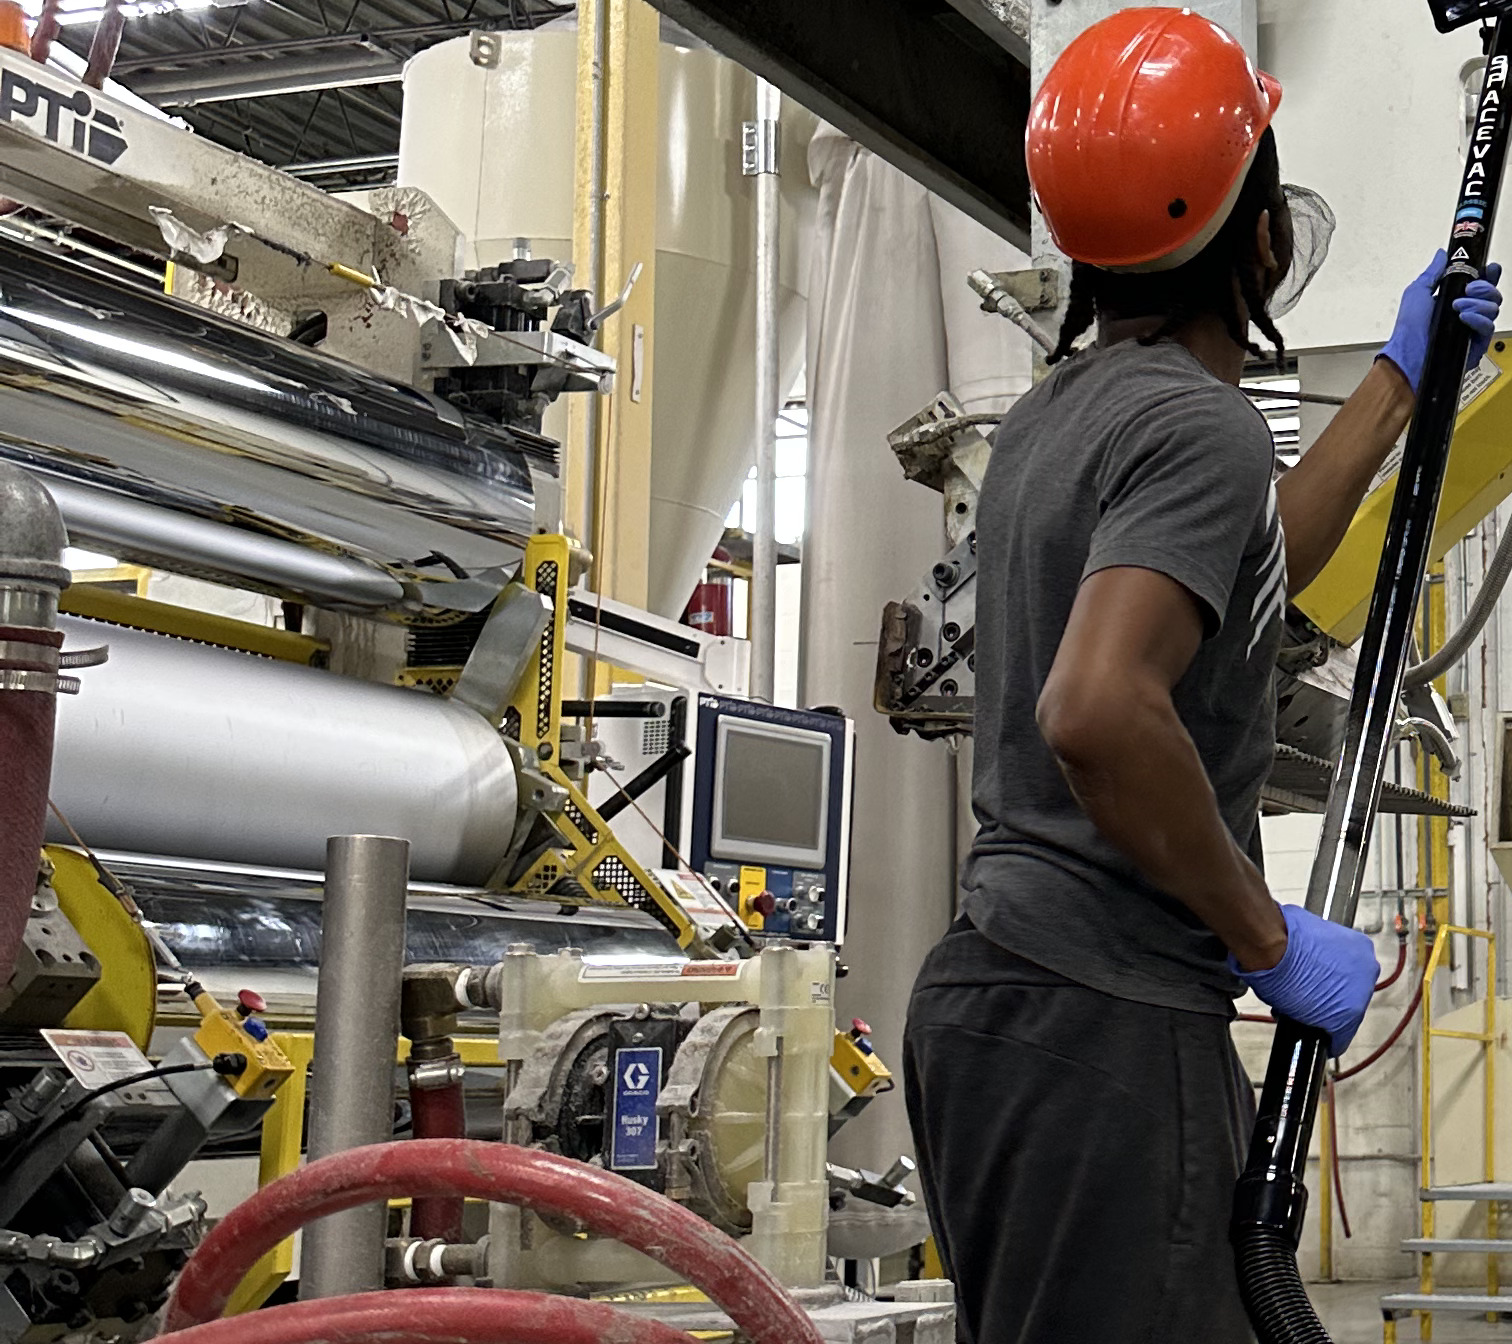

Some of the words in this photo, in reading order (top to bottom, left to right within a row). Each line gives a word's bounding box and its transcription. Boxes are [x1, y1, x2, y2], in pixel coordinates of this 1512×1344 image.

[1464, 55, 1508, 197] SPACEVAC
[621, 1115, 649, 1126] Husky
[625, 1127, 643, 1136] 307
